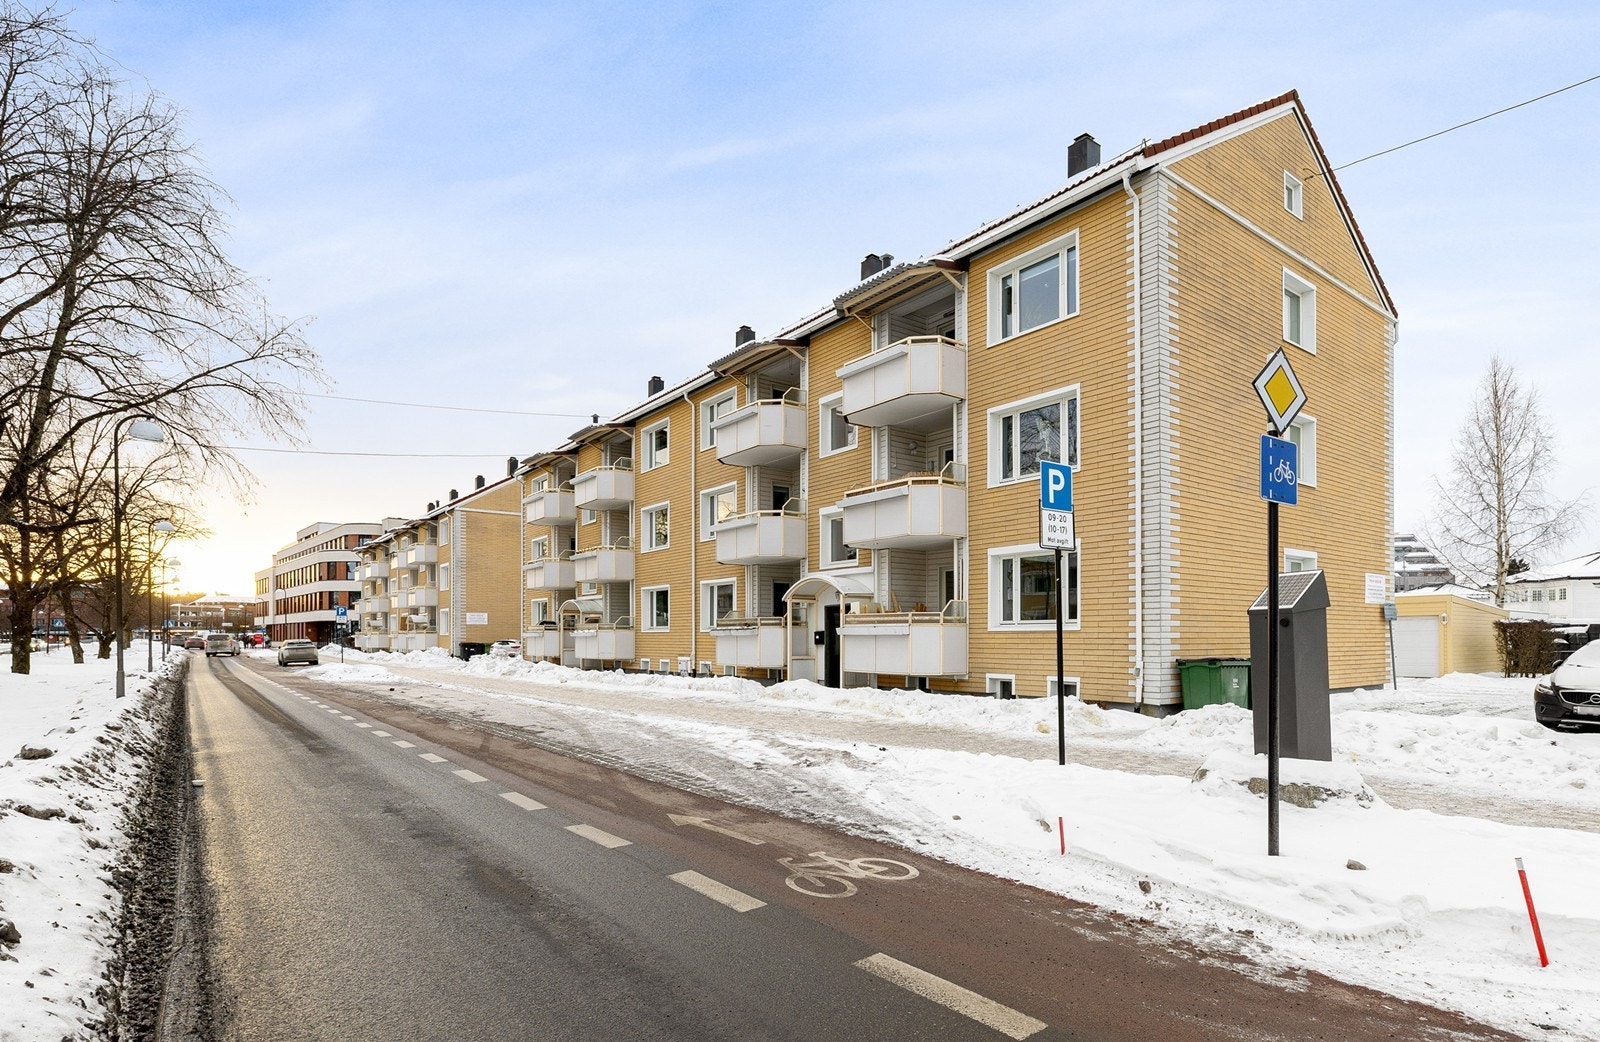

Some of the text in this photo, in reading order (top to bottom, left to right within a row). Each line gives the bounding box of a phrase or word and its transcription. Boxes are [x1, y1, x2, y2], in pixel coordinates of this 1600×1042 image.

[1048, 468, 1065, 504] P
[1047, 513, 1067, 523] 09-20
[1047, 523, 1068, 535] (10-17)
[338, 607, 345, 615] P
